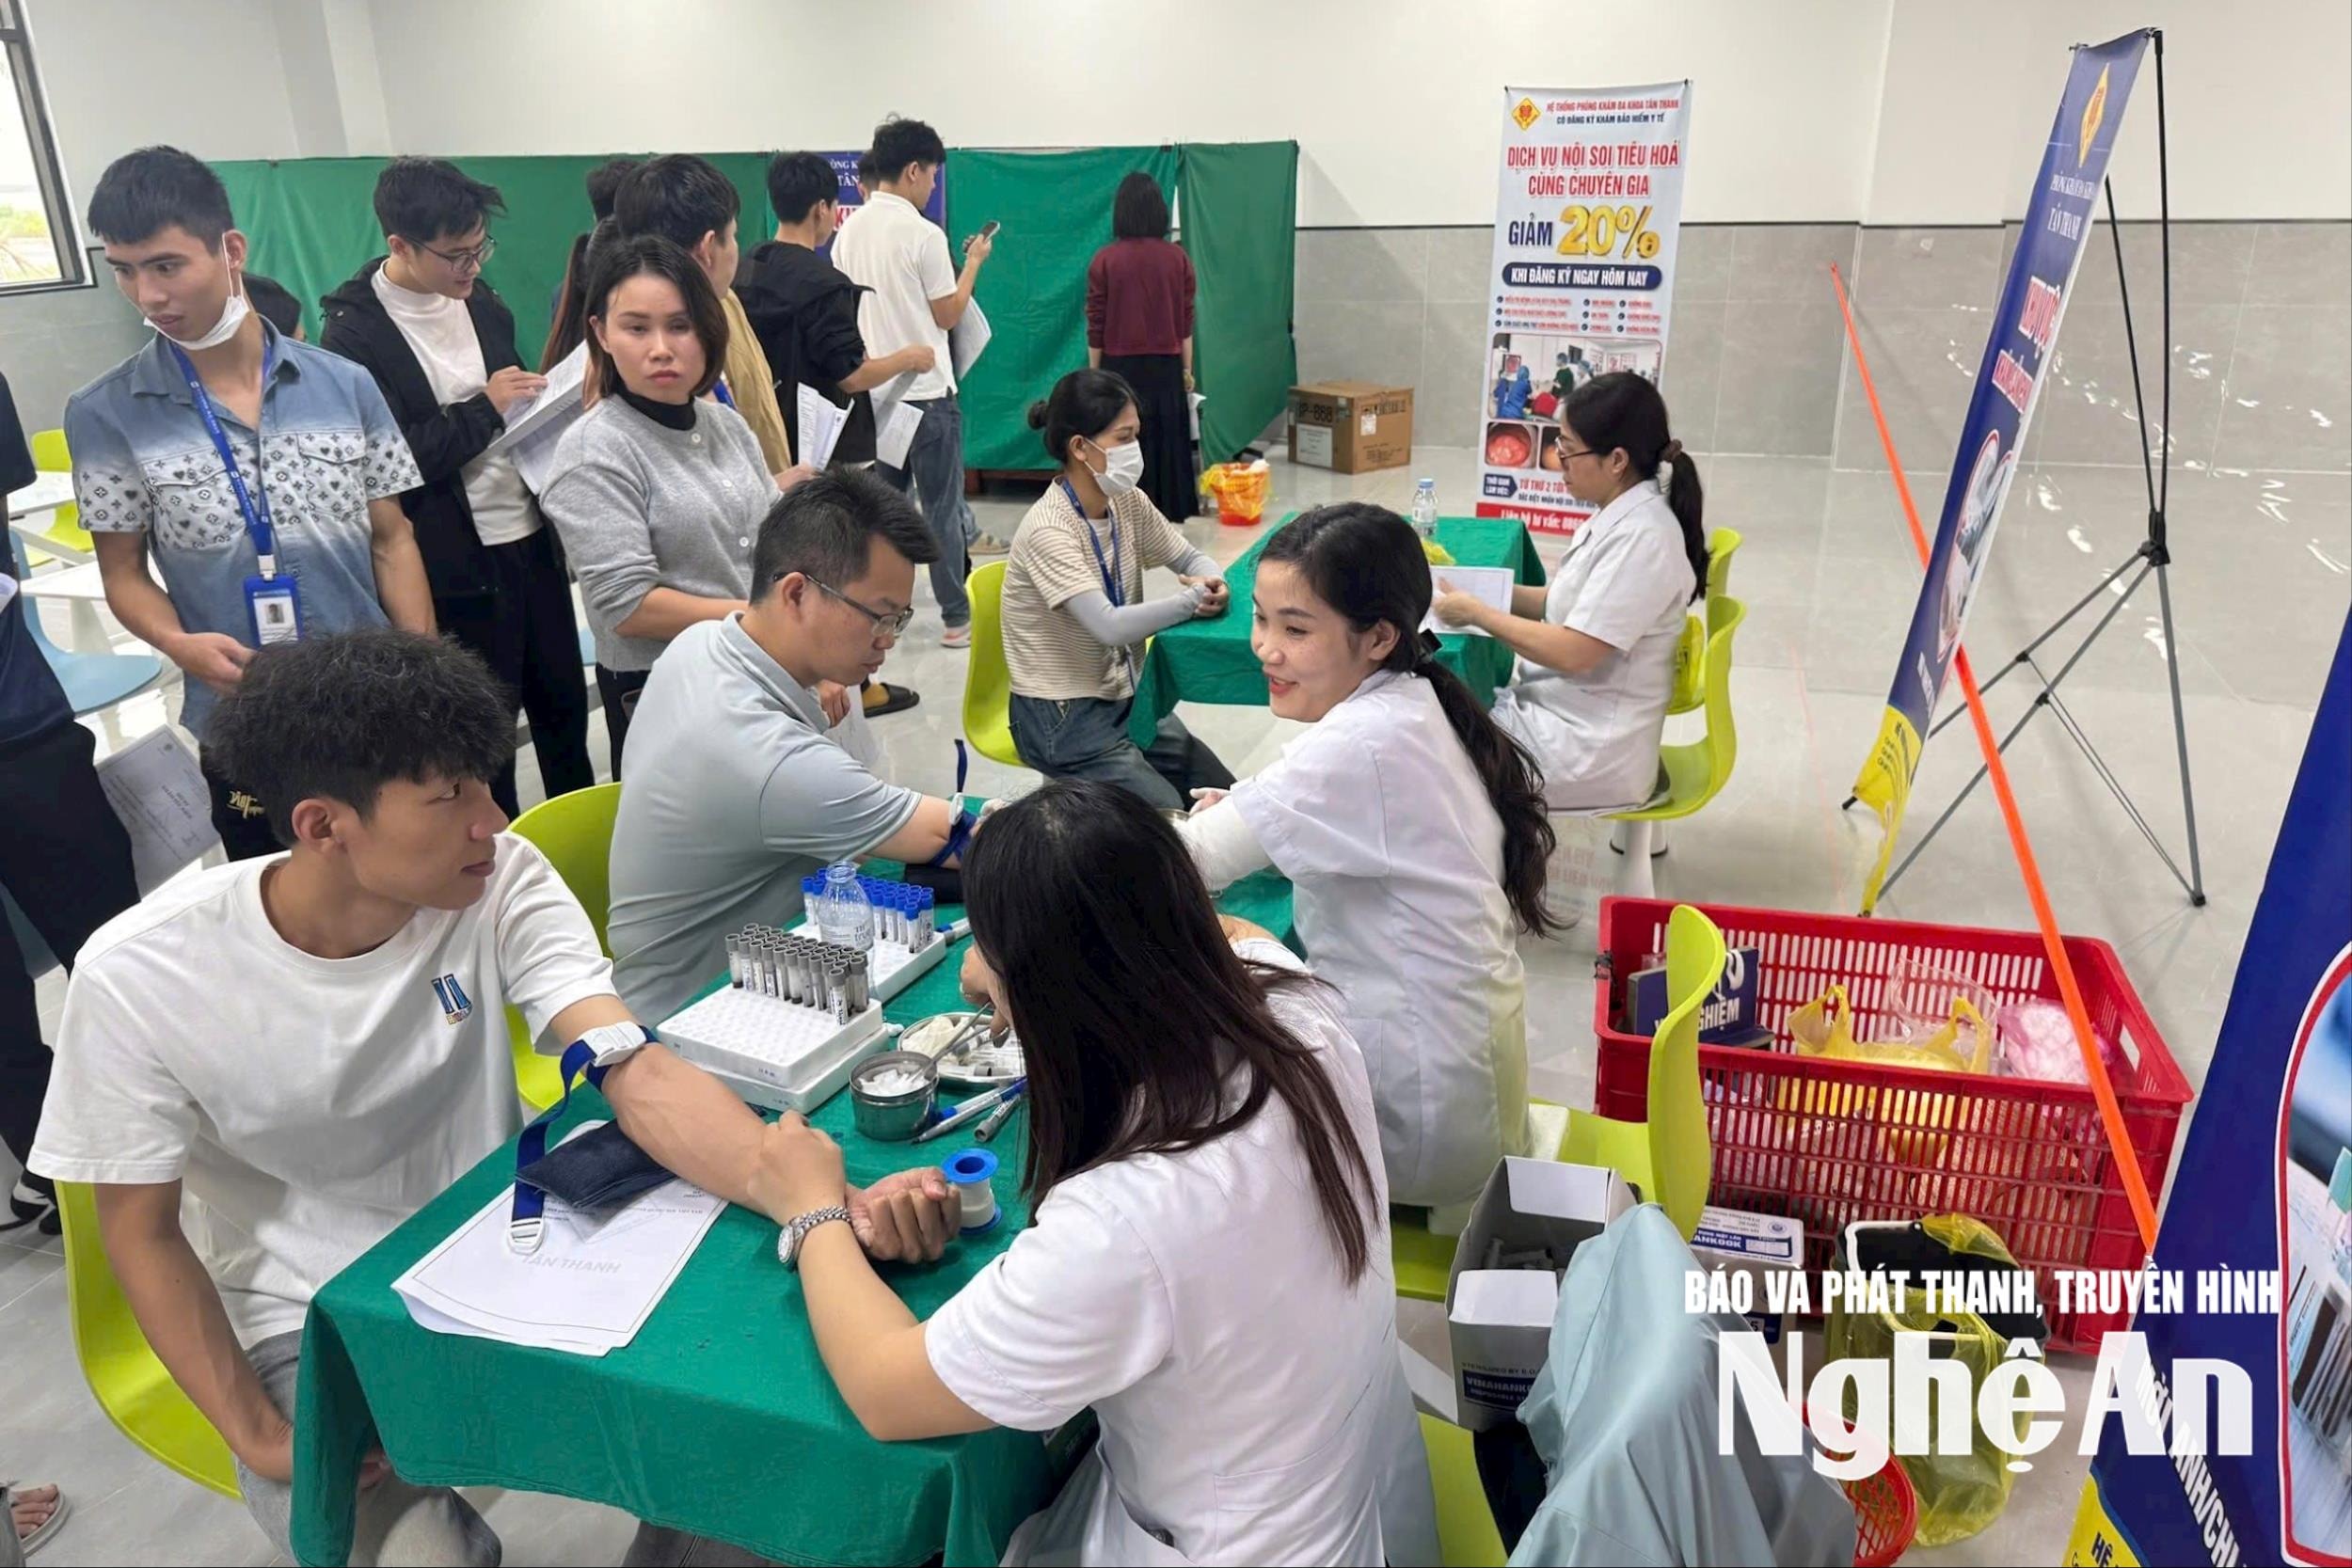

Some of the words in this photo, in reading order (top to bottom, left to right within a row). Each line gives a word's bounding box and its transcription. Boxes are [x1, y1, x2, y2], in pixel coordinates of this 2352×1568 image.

[830, 158, 850, 169] ÒNG
[1507, 146, 1536, 173] DỊCH
[1540, 145, 1558, 171] VỤ
[1562, 141, 1586, 171] NỘI
[1589, 145, 1613, 166] SOI
[1617, 141, 1646, 166] TIÊU
[1569, 170, 1623, 196] CHUYÊN
[1627, 175, 1649, 196] GIA
[1509, 213, 1553, 246] GIẢM
[1557, 205, 1661, 260] 20%
[1511, 267, 1528, 282] KHI
[1529, 265, 1556, 284] ĐĂNG
[1557, 266, 1573, 284] KÝ
[1573, 269, 1599, 285] NGAY
[1601, 267, 1626, 286] HÔM
[1627, 271, 1648, 286] NAY
[1699, 997, 1740, 1033] GHIỆM
[1694, 1234, 1741, 1248] ANKOOK
[1466, 1376, 1532, 1392] VINAHANK
